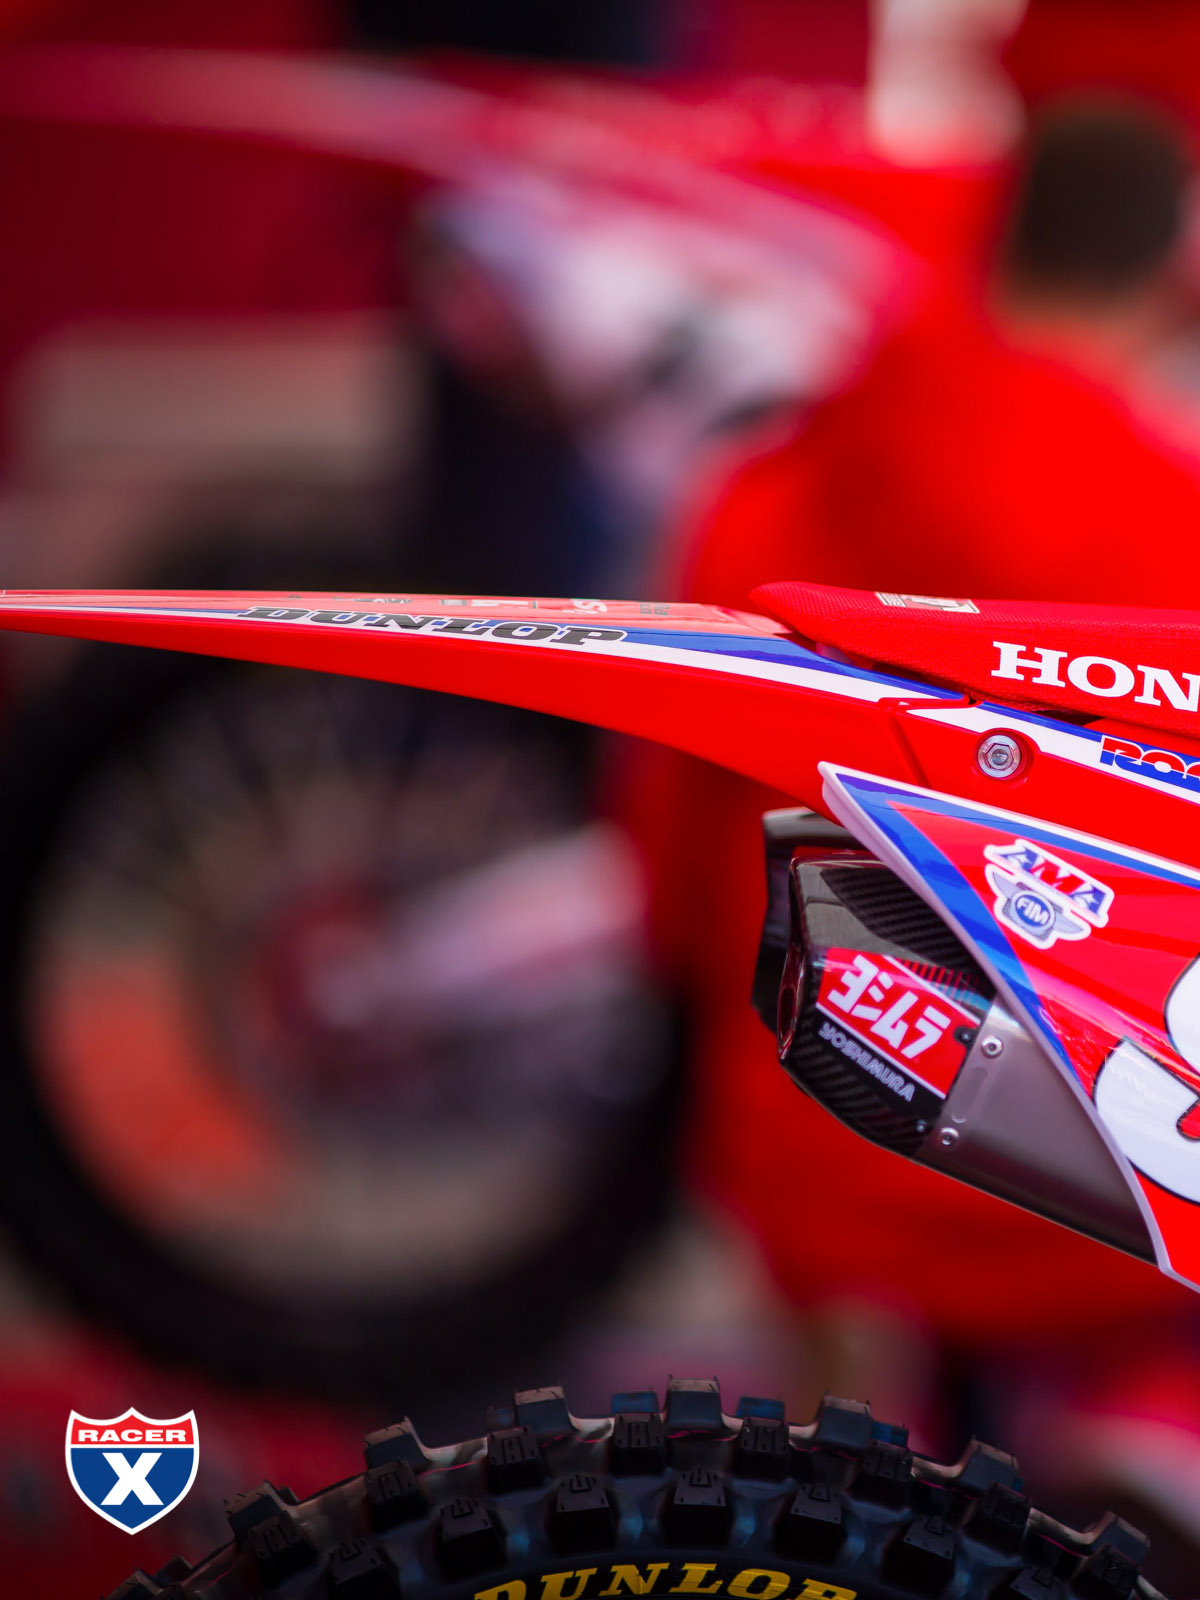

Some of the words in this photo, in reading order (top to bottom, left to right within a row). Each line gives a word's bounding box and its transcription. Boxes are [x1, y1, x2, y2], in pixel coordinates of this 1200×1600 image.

[237, 605, 628, 646] DUNLOP
[993, 847, 1106, 919] AMA
[1016, 897, 1050, 925] FIM
[827, 953, 952, 1061] ヨシムラ
[818, 1022, 917, 1103] YOSHIMURA
